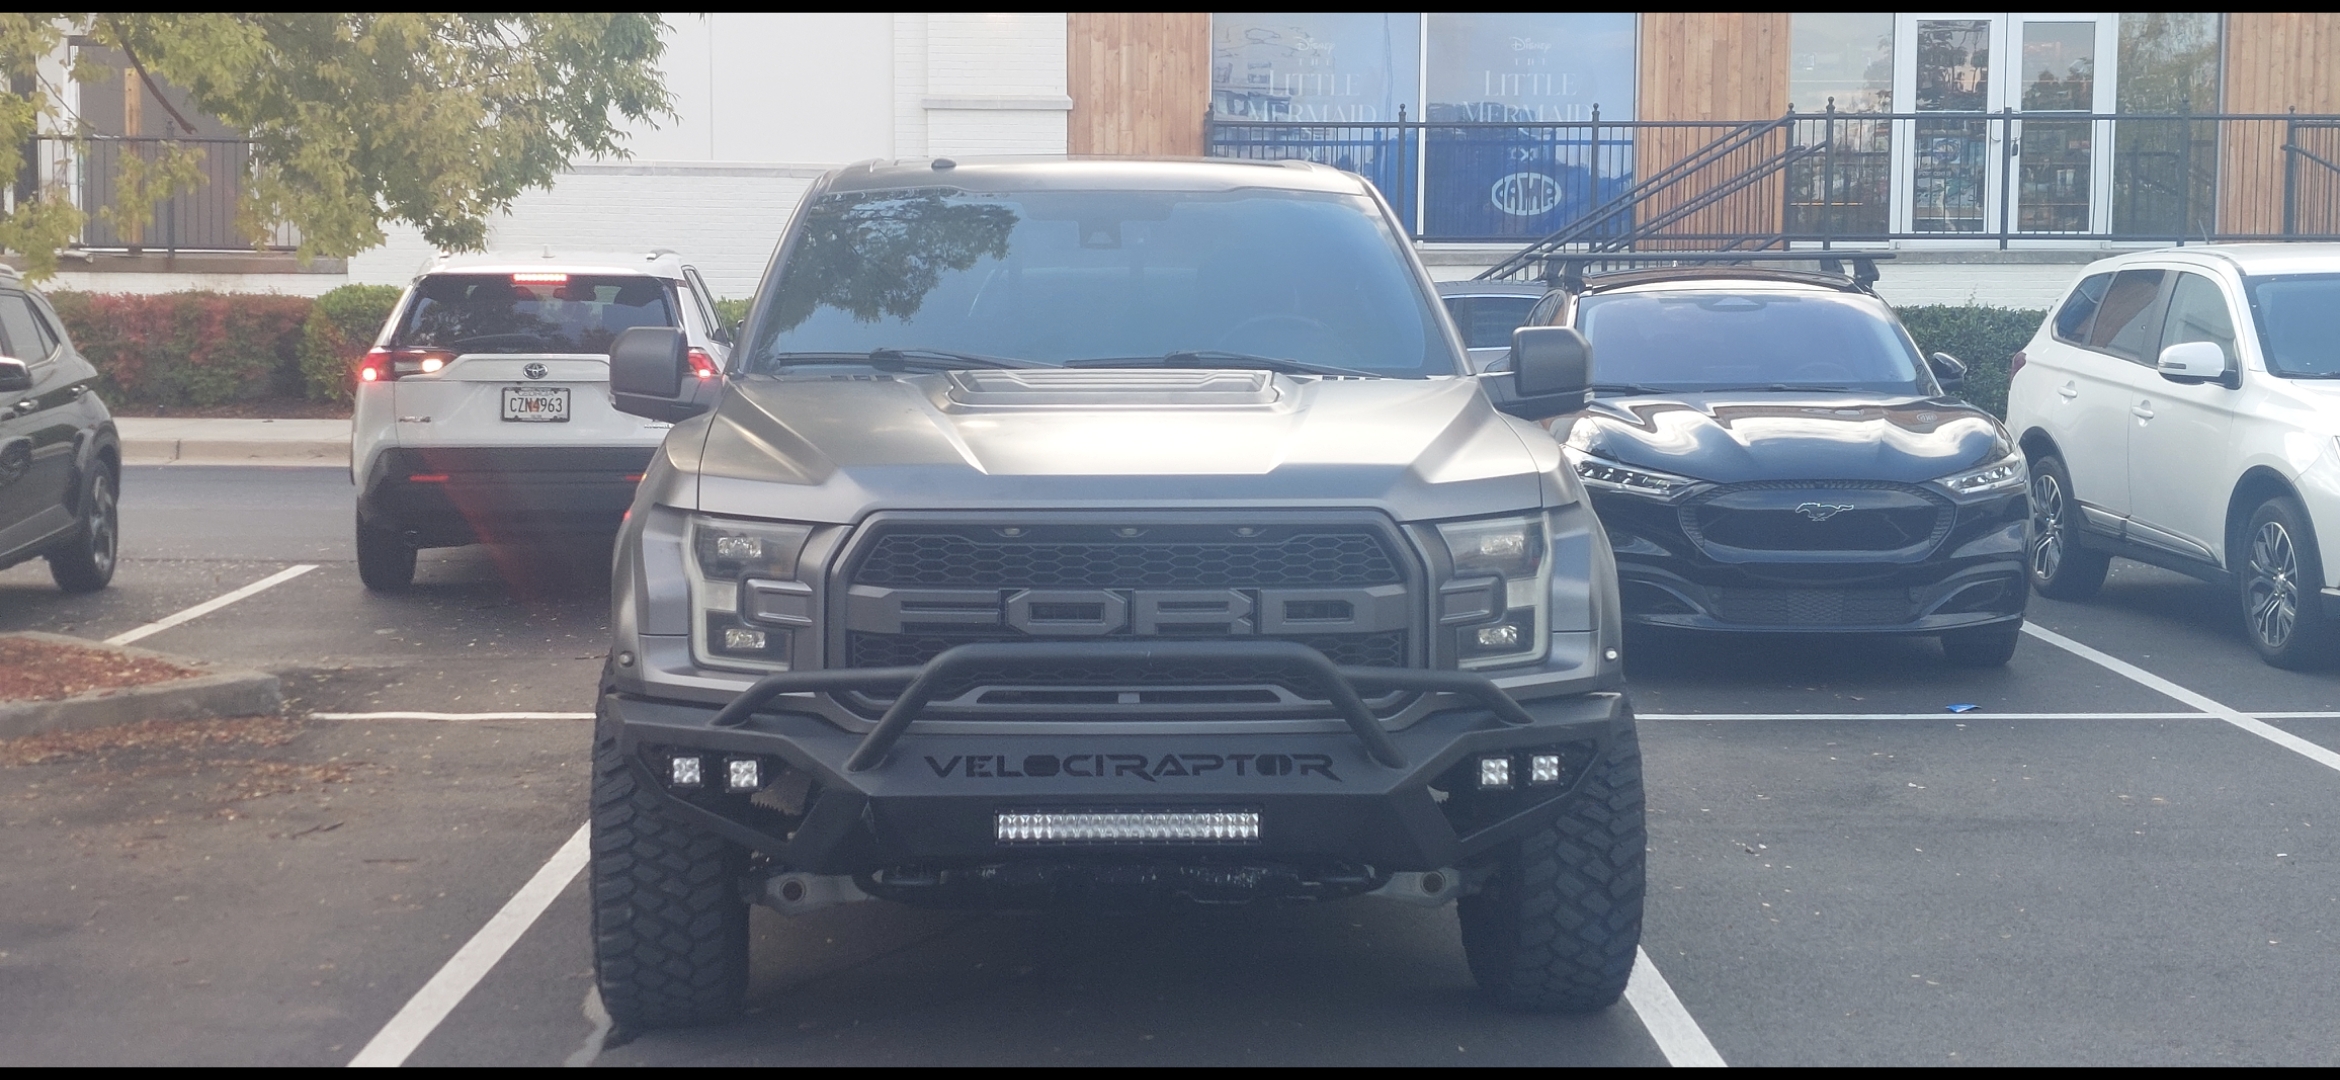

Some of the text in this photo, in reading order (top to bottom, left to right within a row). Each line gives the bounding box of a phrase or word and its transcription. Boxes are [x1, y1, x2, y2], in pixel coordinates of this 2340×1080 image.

[1294, 36, 1336, 54] Disney
[1509, 36, 1552, 54] Disney
[1269, 69, 1361, 96] LITTLE
[1484, 69, 1578, 96] LITTLE
[1247, 100, 1378, 122] MERMAID
[1463, 100, 1593, 122] MERMAID
[510, 397, 562, 413] CZN4963
[843, 588, 1406, 636] FORD
[924, 753, 1343, 782] VELOCIRAPTOR
